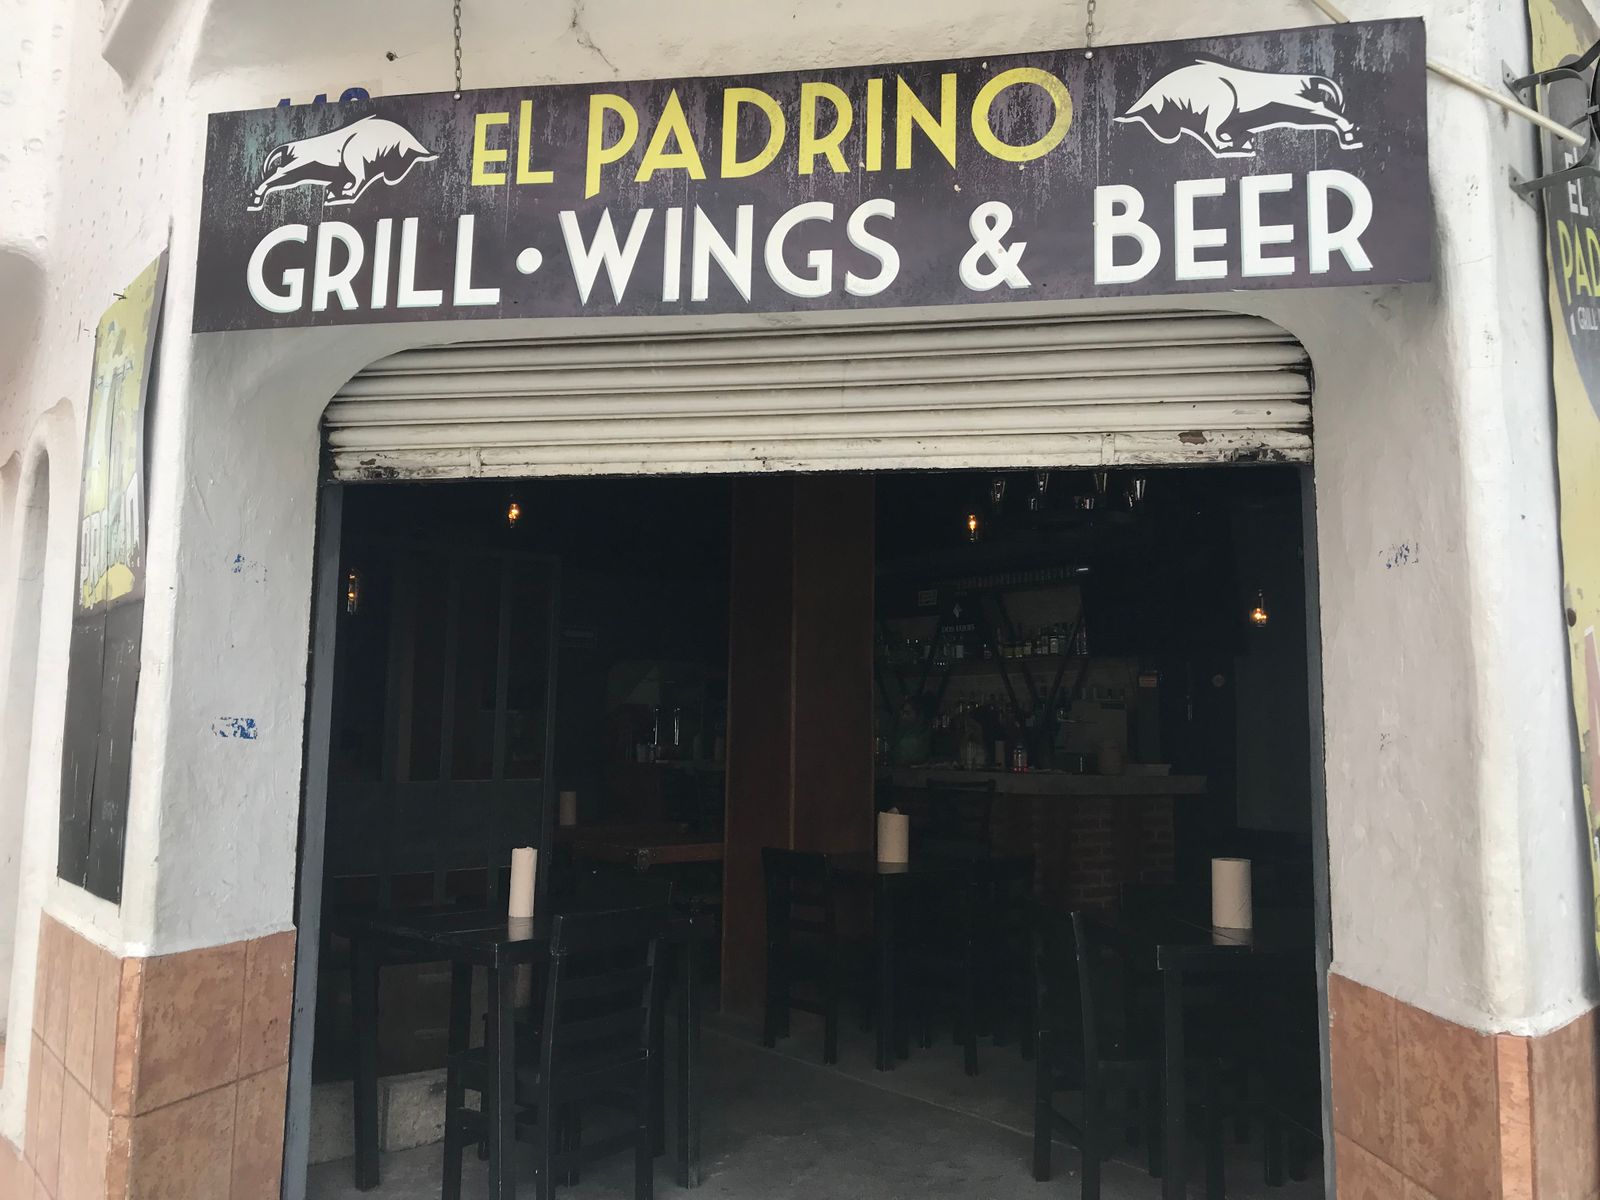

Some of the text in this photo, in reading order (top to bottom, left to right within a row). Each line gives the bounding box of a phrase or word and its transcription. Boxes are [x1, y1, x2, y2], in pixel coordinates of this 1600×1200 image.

[471, 67, 1073, 199] EL PADRINO
[246, 169, 1374, 314] GRILL WINGS & BEER
